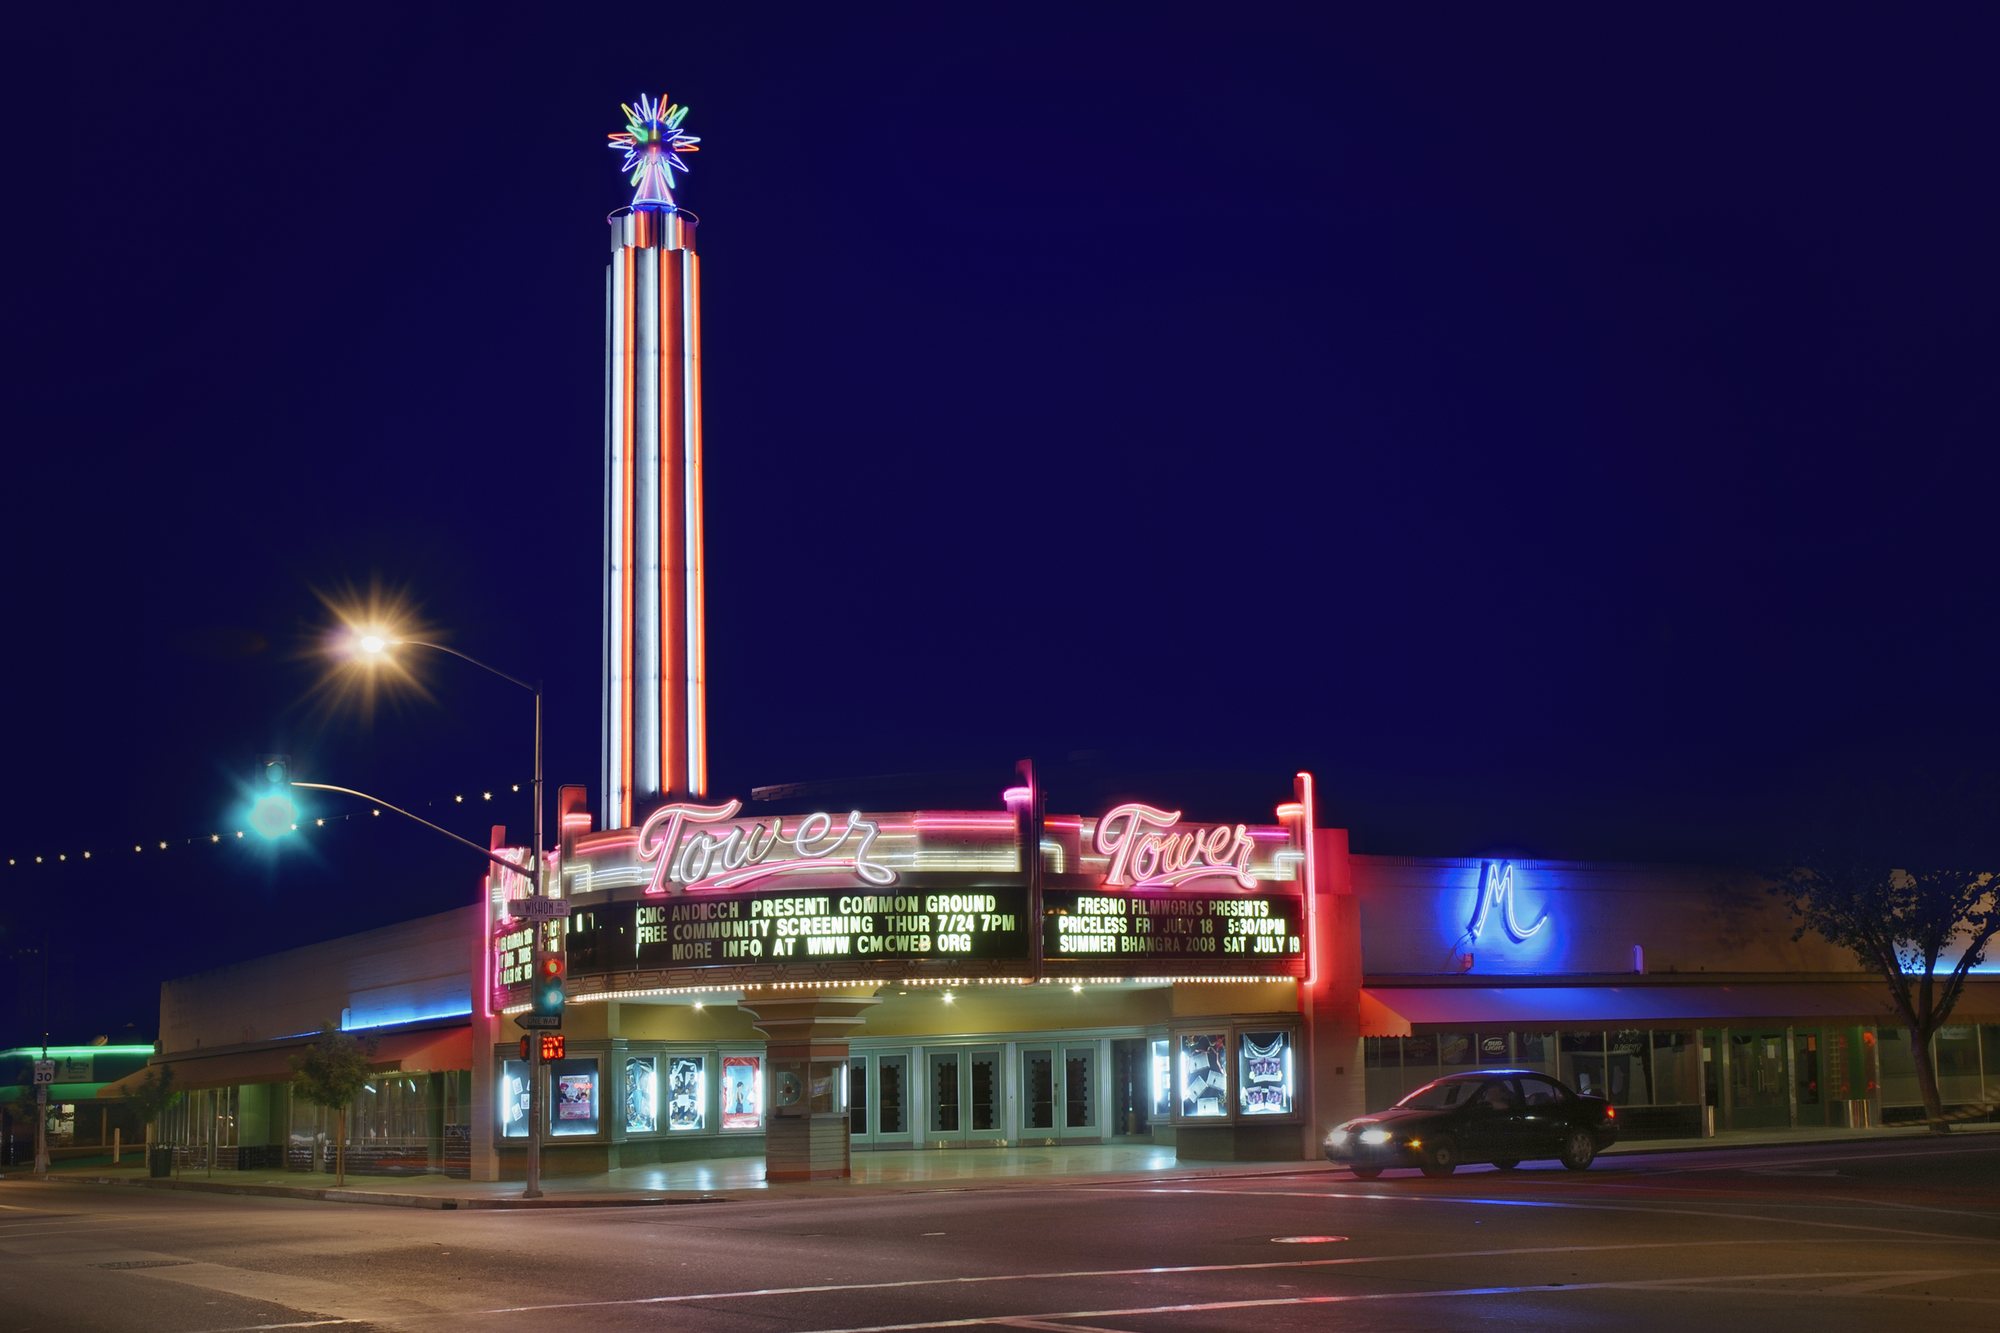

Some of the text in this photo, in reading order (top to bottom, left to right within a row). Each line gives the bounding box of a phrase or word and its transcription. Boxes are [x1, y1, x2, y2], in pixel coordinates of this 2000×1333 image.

[637, 799, 898, 895] Tower
[1095, 803, 1257, 889] Tower
[524, 901, 554, 915] WISHON
[637, 894, 996, 925] CMC AND CCH PRESENT COMMON GROUND
[1077, 897, 1269, 917] FRESNO FILMWORKS PRESENTS
[638, 914, 1015, 944] FREE COMMUNITY SCREENING THUR 7/24 7PM
[1058, 916, 1285, 935] PRICELESS FRI JULY 18 5:30/8PM
[672, 934, 971, 961] MORE INFO AT WWW CMCWEB ORG
[1060, 935, 1300, 954] SUMMER BHANGRA 2008 SAT JULY 19
[543, 1017, 556, 1025] WAY
[36, 1072, 52, 1082] 30
